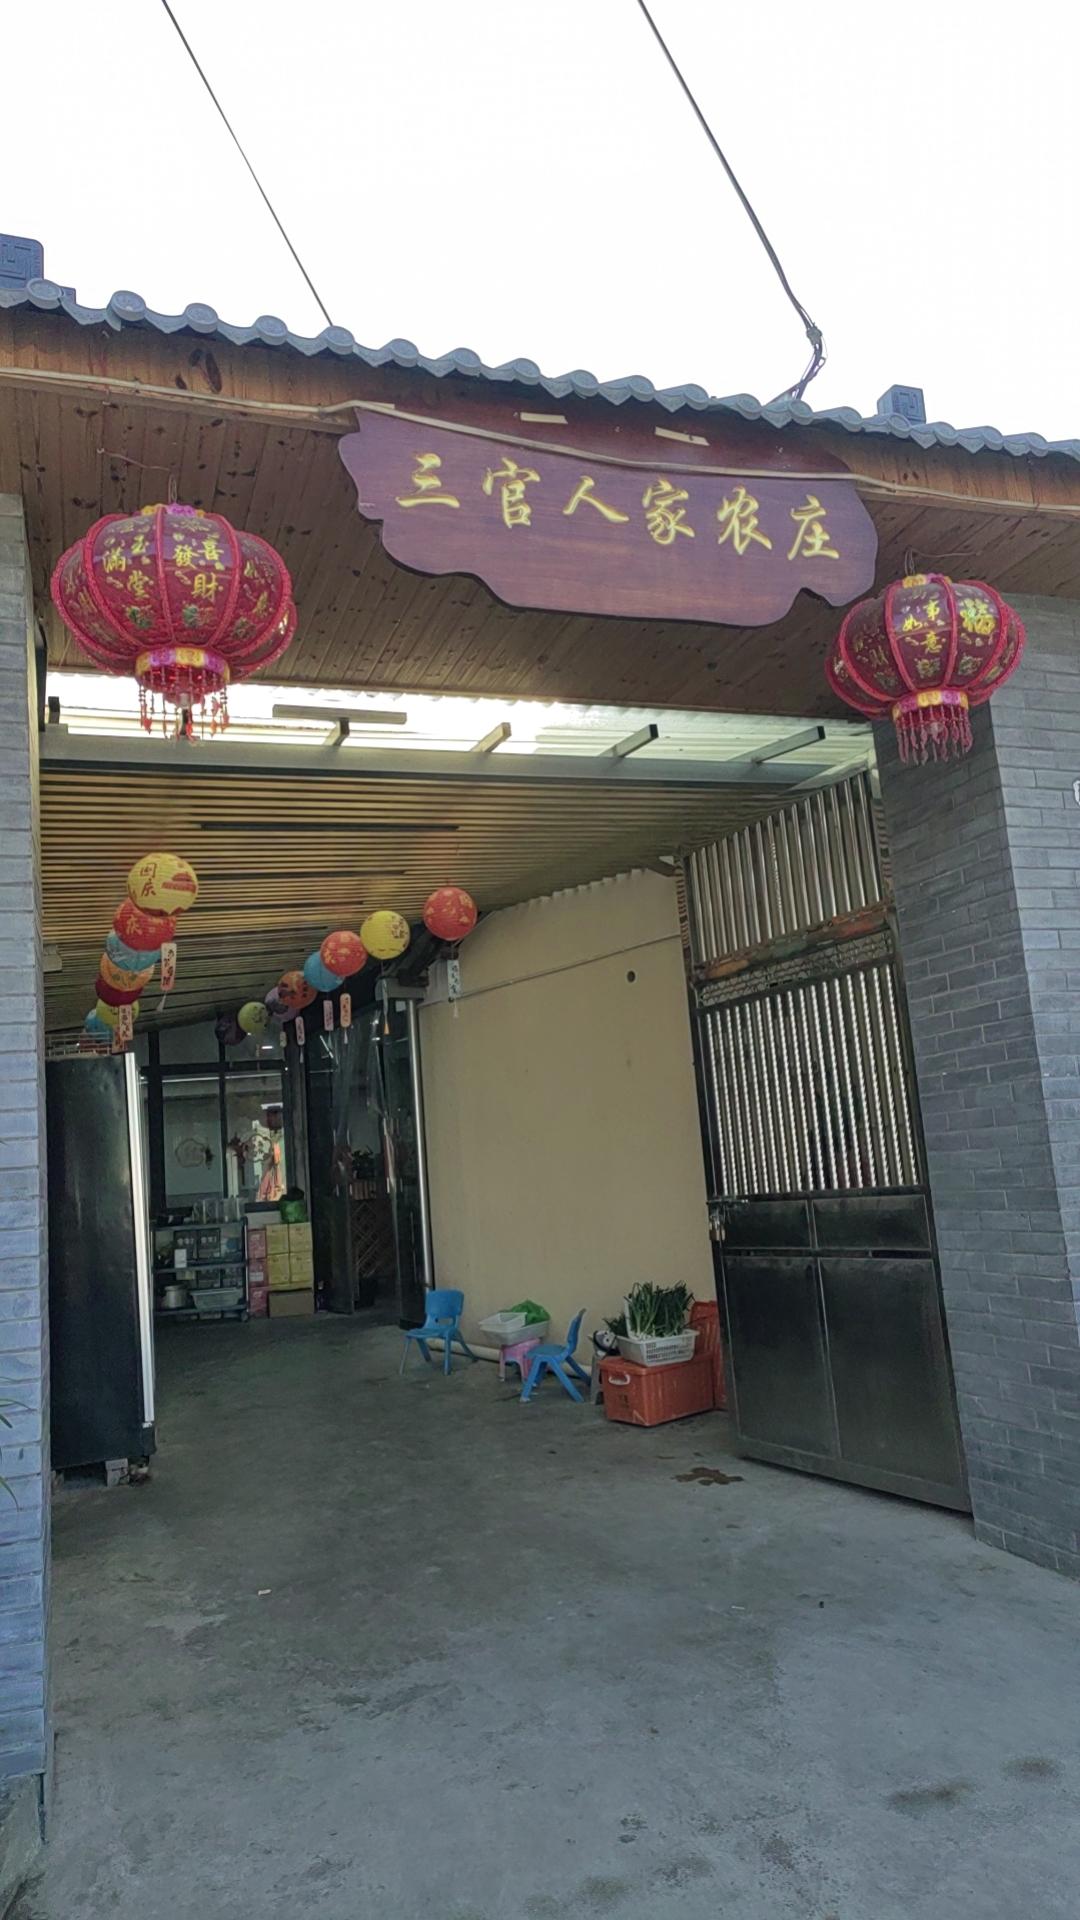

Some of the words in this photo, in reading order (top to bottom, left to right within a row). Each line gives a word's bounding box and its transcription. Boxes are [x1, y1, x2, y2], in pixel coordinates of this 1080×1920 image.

[394, 452, 840, 561] 三官人家农庄
